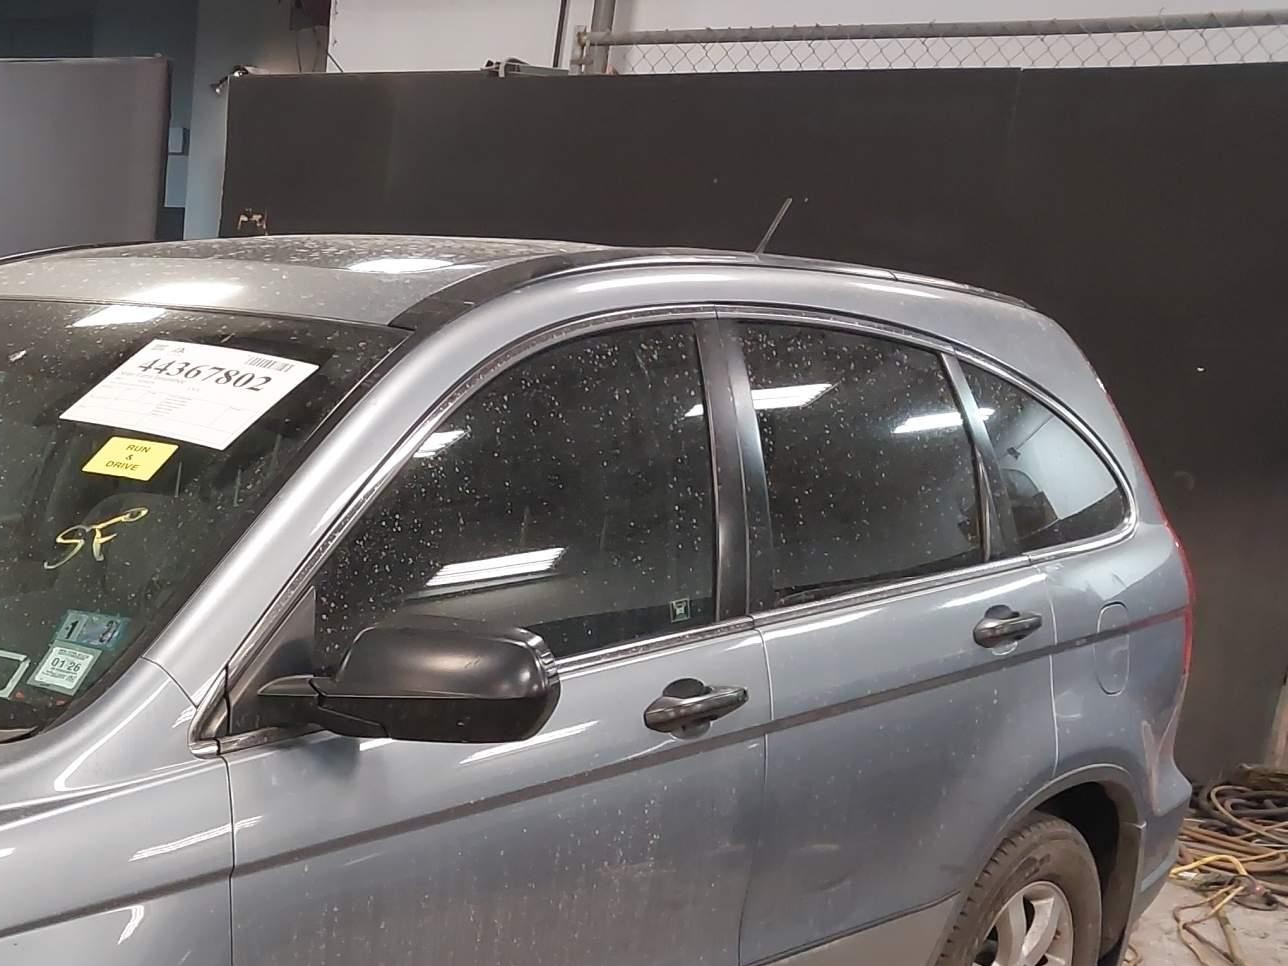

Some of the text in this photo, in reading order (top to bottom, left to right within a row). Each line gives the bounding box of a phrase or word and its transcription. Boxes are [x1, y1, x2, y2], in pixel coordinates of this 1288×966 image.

[138, 357, 273, 392] 44367802
[126, 444, 151, 453] RUN
[105, 460, 140, 471] DRIVE
